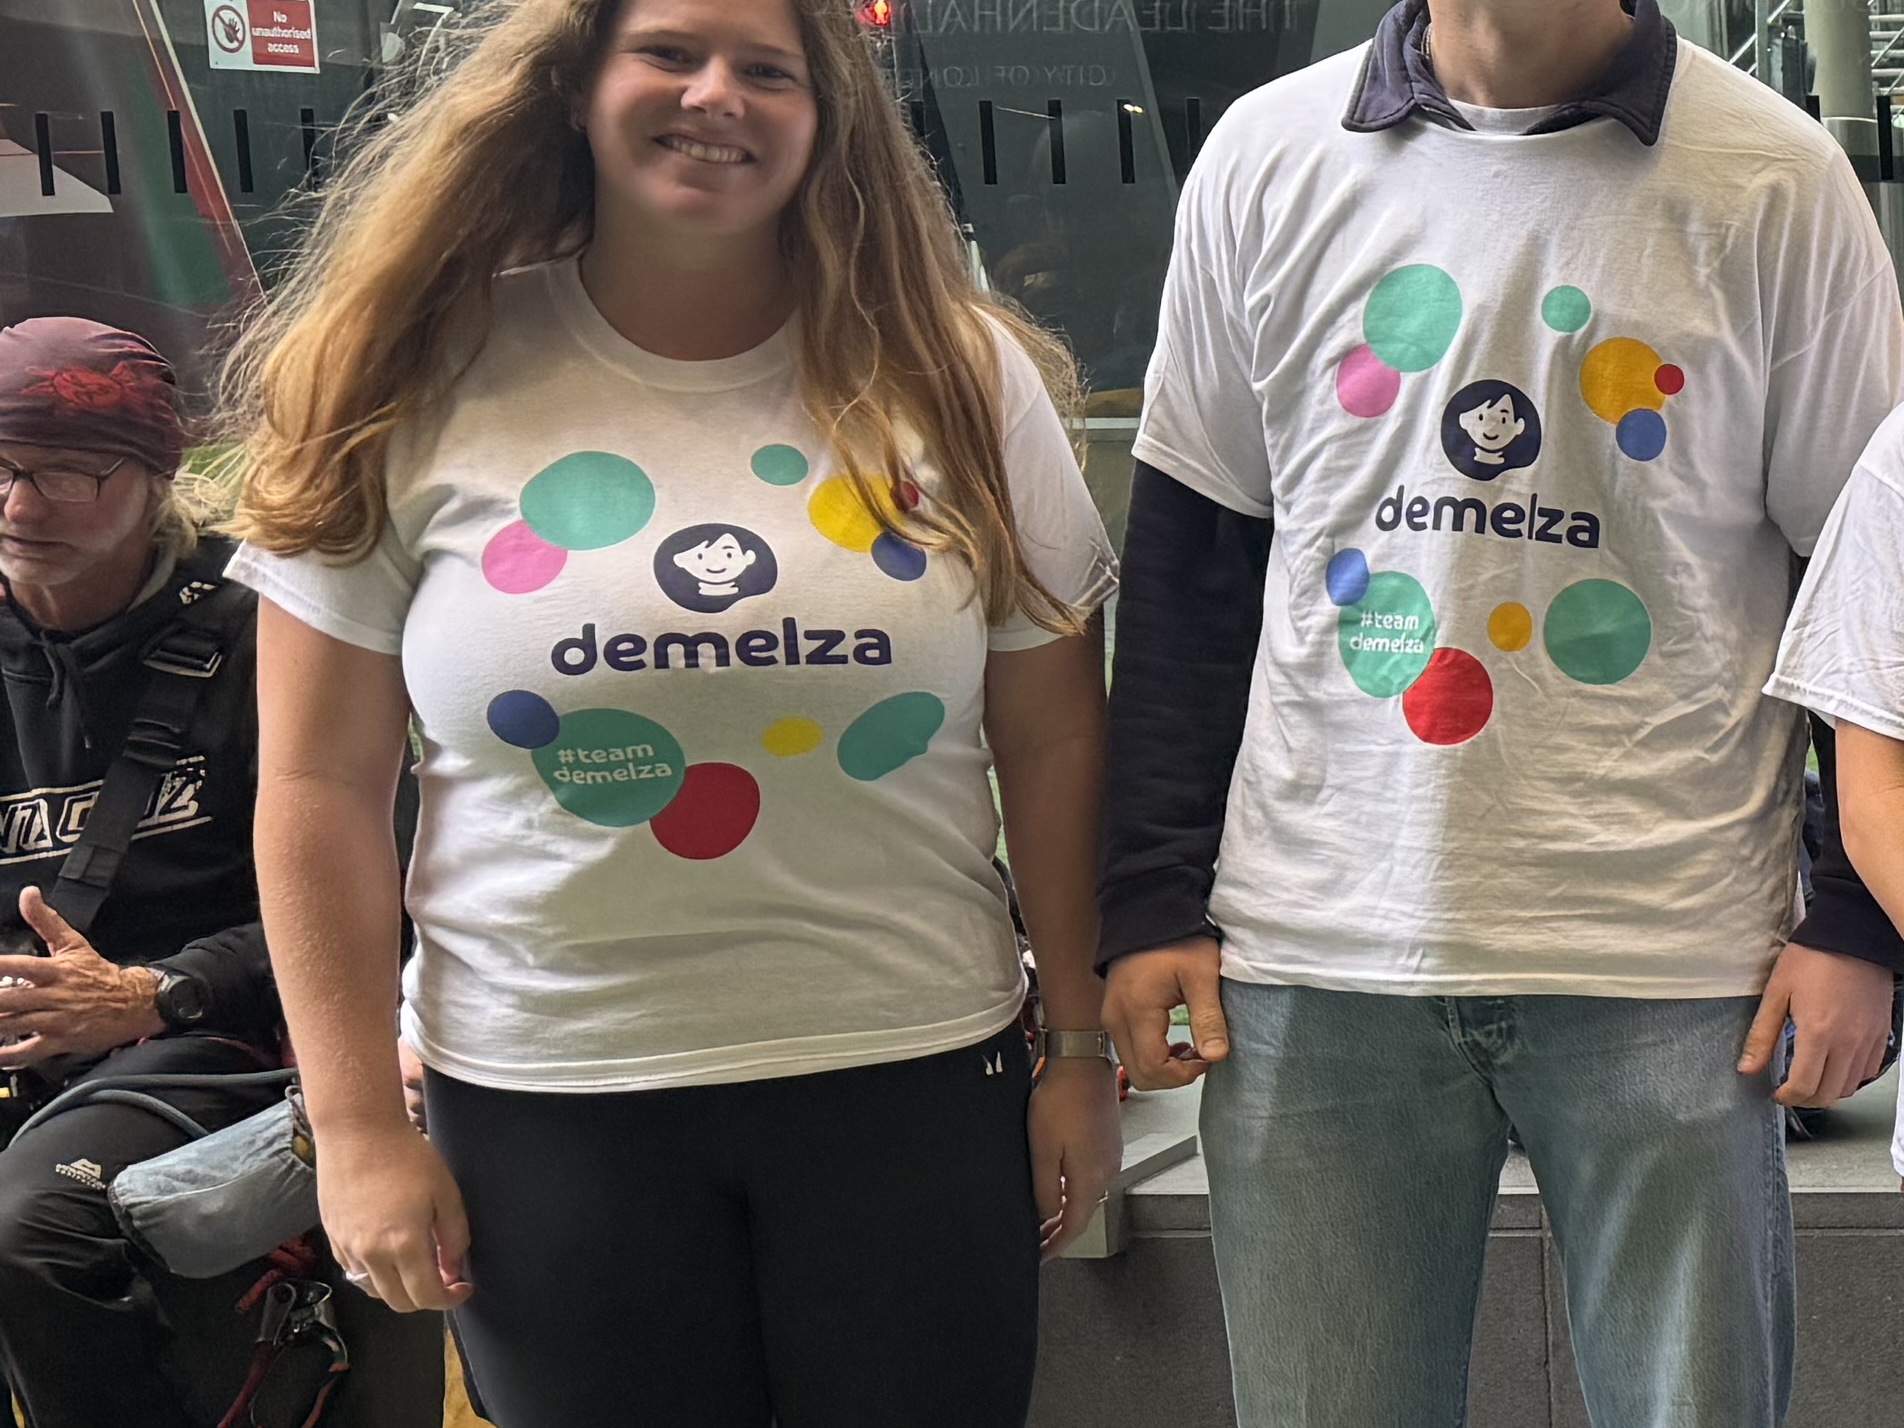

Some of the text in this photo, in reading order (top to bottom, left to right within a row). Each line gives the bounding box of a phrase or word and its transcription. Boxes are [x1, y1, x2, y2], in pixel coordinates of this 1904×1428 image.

[273, 11, 288, 23] No
[252, 27, 312, 40] unauthorised
[267, 43, 299, 54] access
[1375, 484, 1601, 549] demelza
[1361, 610, 1419, 631] #team
[550, 617, 892, 676] demelza
[1349, 633, 1425, 654] demelza
[557, 743, 654, 764] #team
[554, 761, 673, 786] demelza
